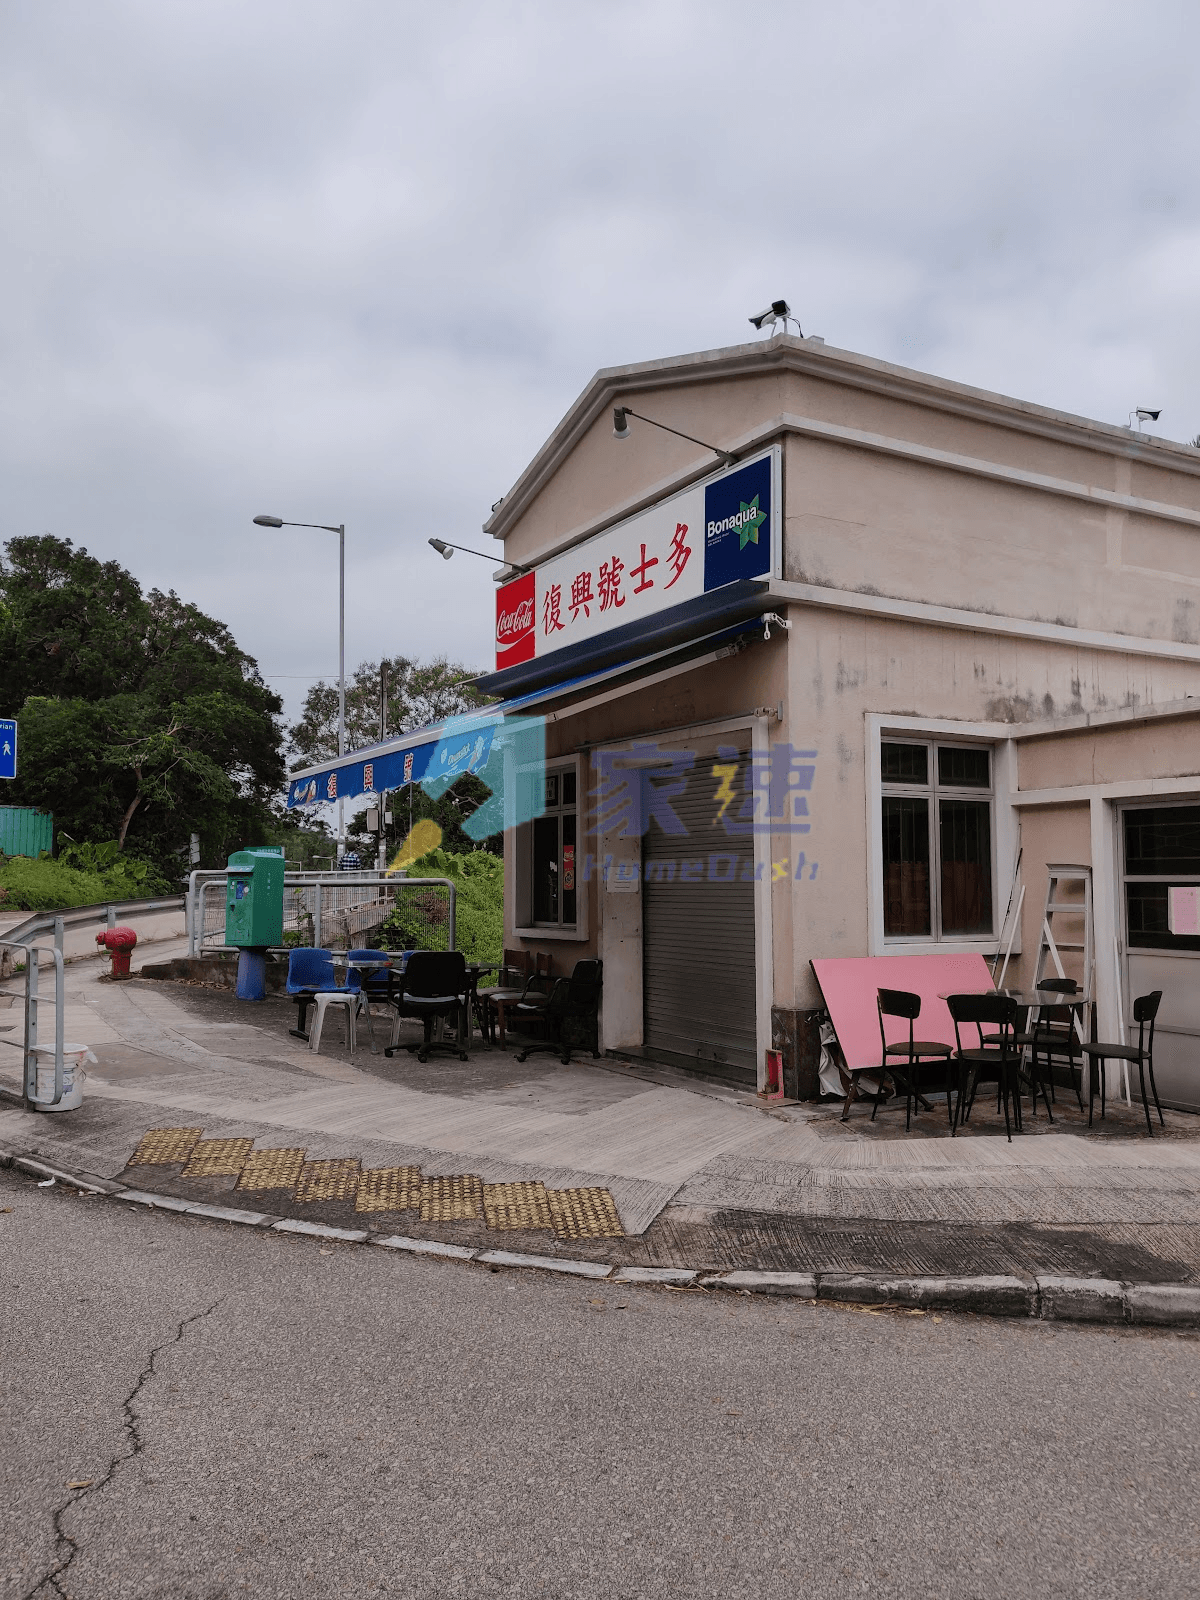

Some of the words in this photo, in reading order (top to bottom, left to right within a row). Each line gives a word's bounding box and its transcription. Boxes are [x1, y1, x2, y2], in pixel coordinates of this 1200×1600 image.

[707, 506, 757, 538] Bonaqua
[542, 523, 693, 637] 復興號士多
[497, 597, 534, 639] Coca-Cola
